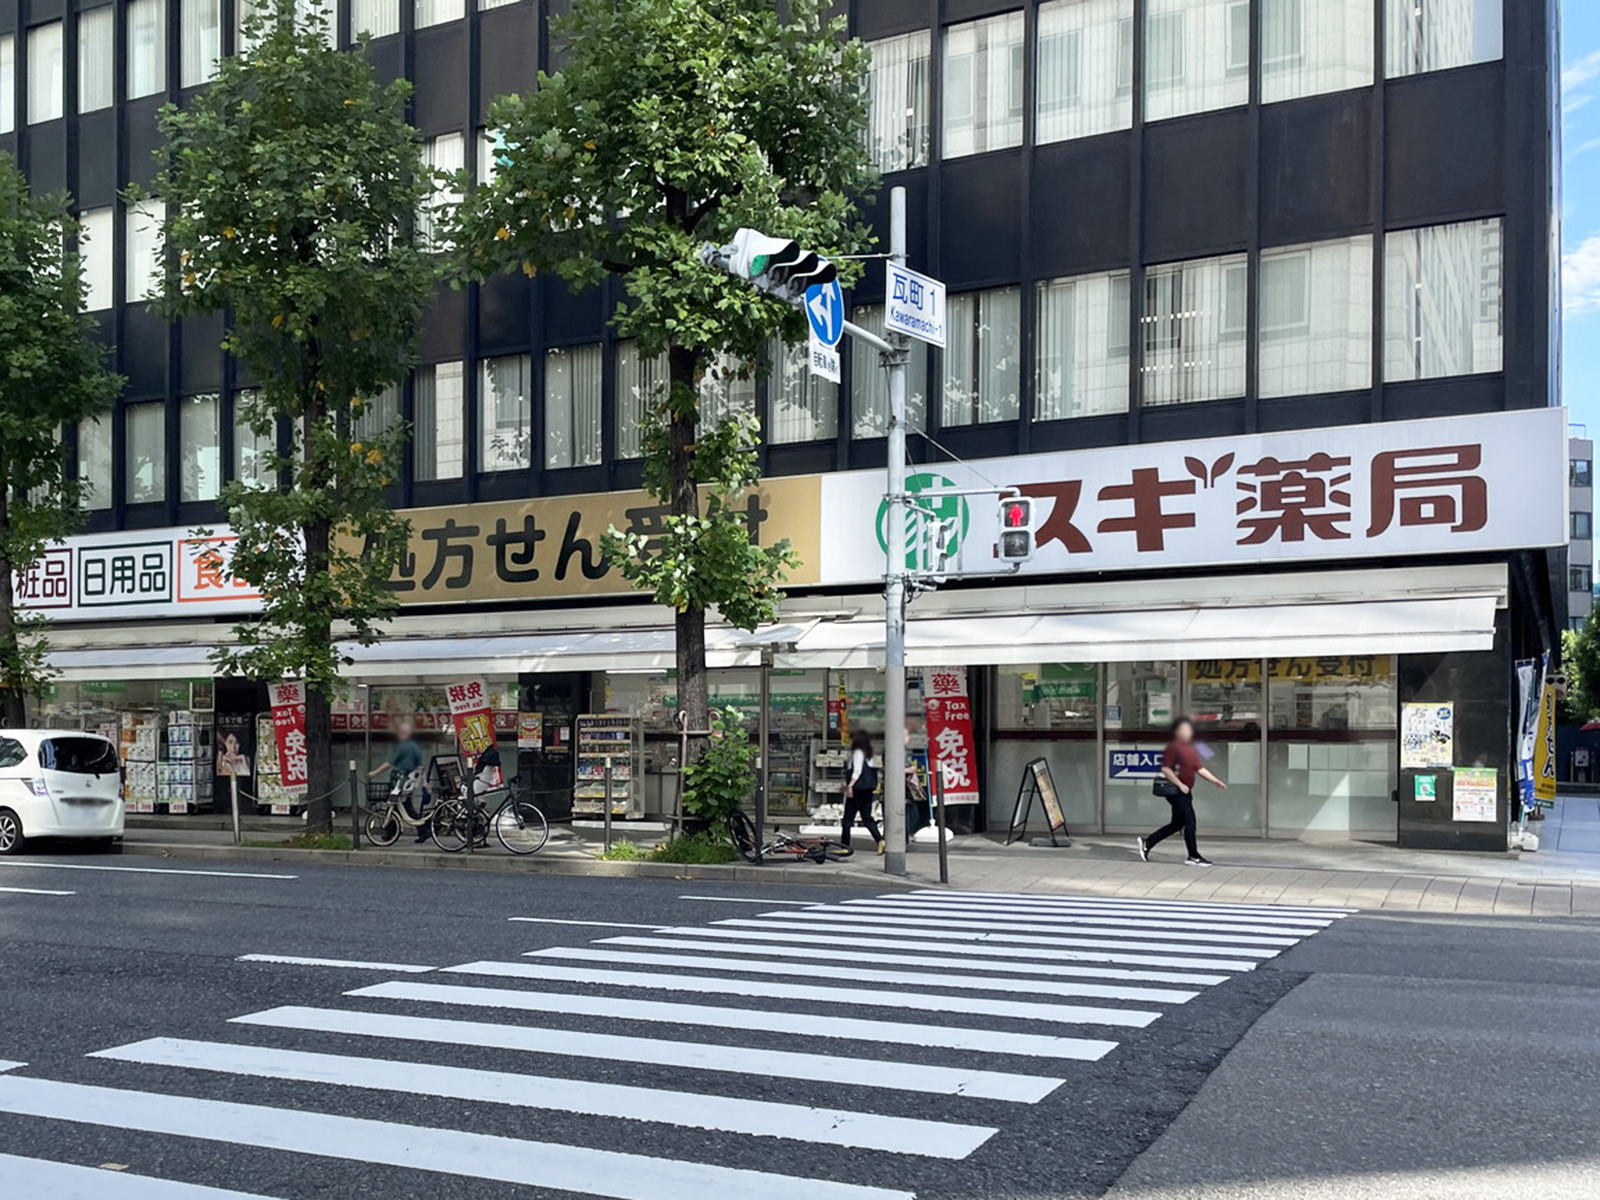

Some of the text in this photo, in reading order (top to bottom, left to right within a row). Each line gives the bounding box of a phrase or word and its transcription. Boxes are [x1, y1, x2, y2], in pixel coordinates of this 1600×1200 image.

[993, 444, 1488, 558] スギ薬局
[85, 553, 166, 596] 日用品
[1195, 656, 1376, 680] 処方せん受付
[945, 701, 967, 711] Tax
[945, 711, 970, 721] Free
[934, 726, 971, 790] 免税
[1112, 752, 1165, 767] 店舗入口
